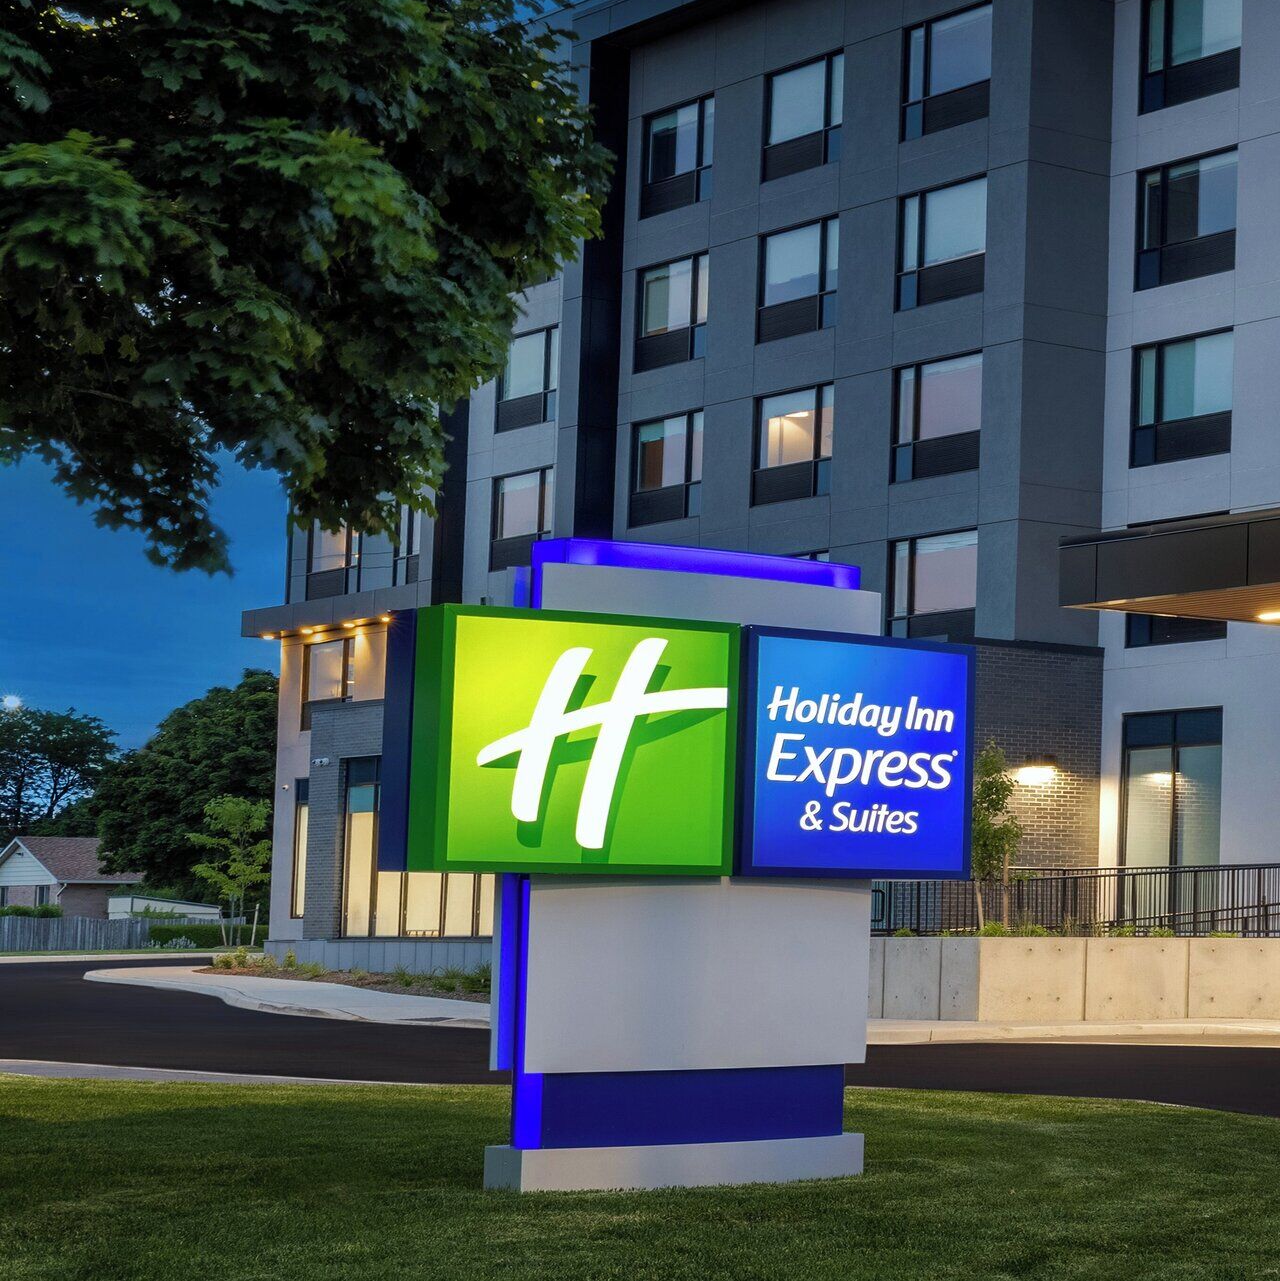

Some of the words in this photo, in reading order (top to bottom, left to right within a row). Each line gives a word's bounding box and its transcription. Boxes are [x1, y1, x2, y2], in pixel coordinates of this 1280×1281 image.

[766, 685, 903, 737] Holiday
[904, 695, 955, 733] Inn
[766, 732, 954, 798] Express
[799, 800, 823, 831] &
[829, 801, 919, 834] Suites
